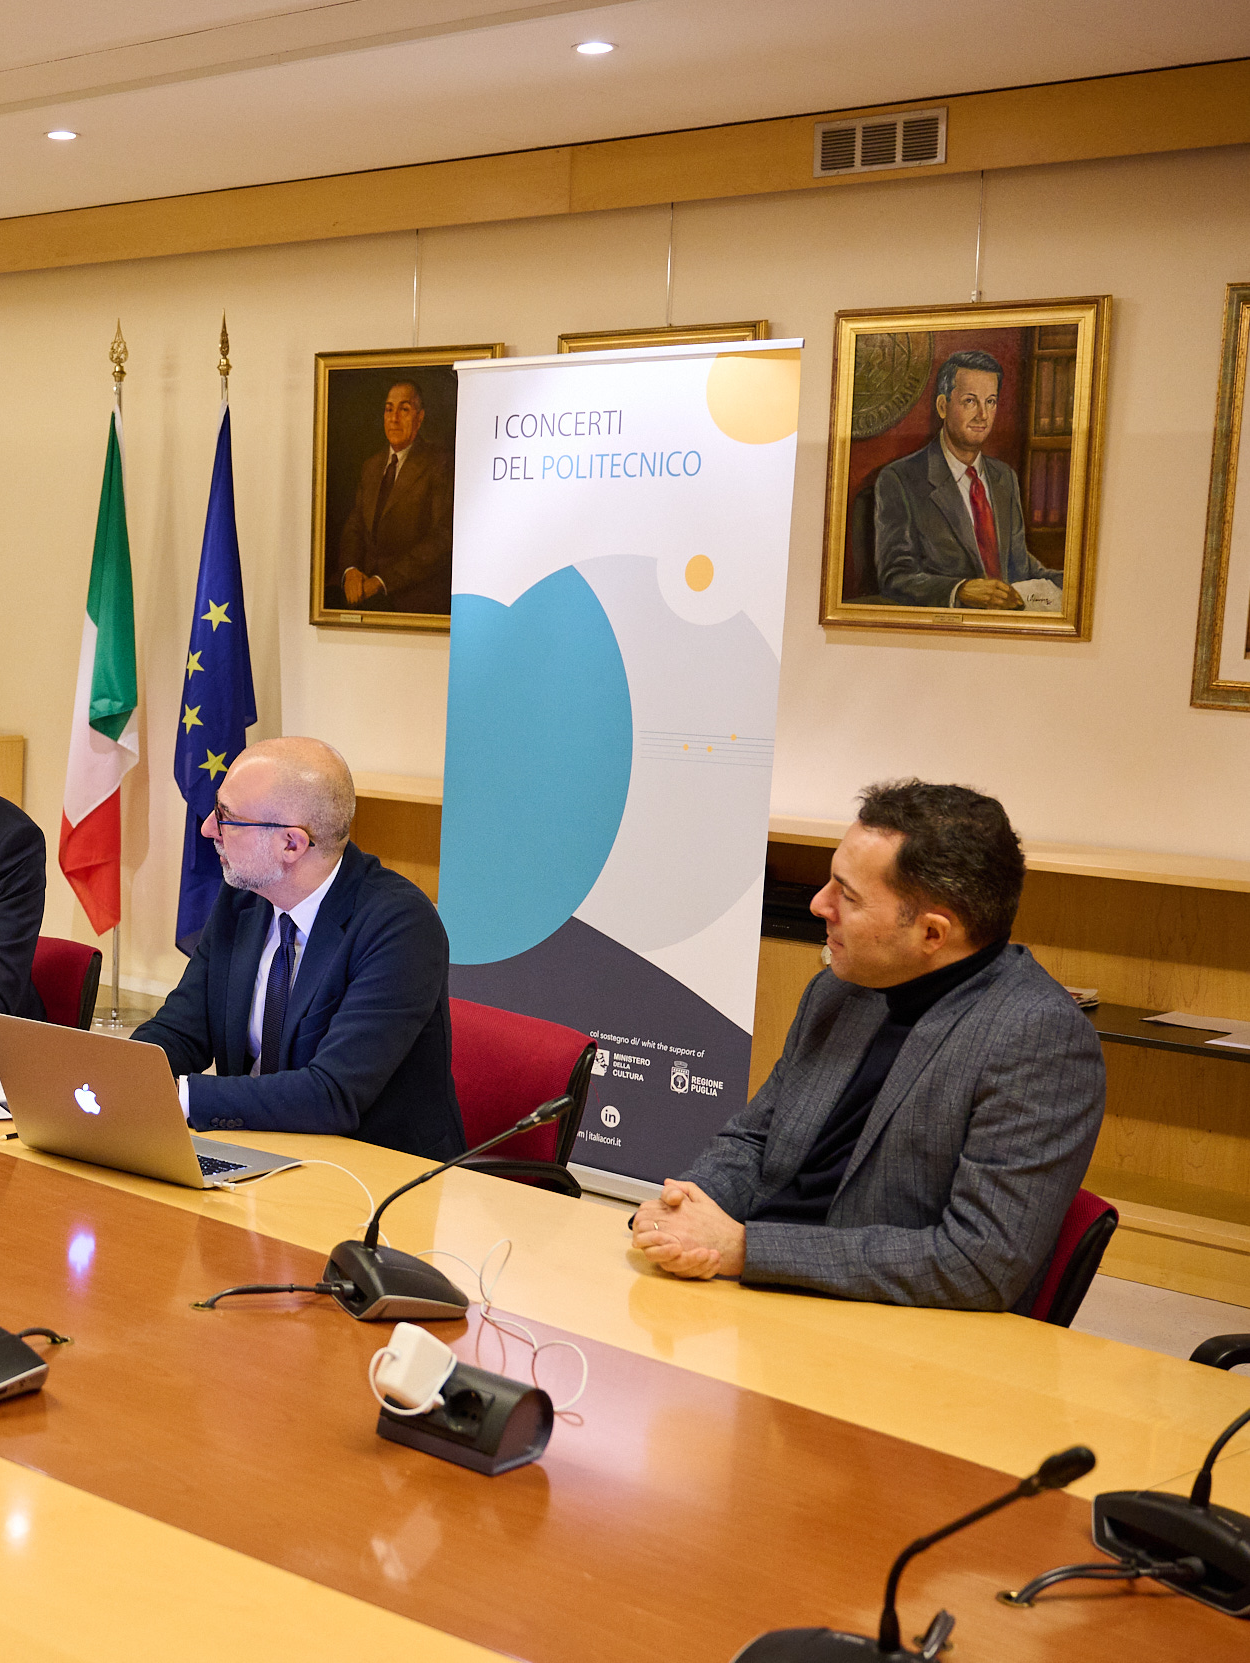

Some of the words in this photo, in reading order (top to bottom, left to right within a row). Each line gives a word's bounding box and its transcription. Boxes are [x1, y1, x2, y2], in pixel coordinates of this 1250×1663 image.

[494, 415, 499, 439] I
[505, 409, 623, 439] CONCERTI
[492, 456, 534, 481] DEL
[542, 450, 702, 480] POLITECNICO
[600, 1033, 629, 1044] sostegno
[642, 1039, 656, 1049] whit
[657, 1042, 668, 1051] the
[669, 1045, 696, 1056] support
[697, 1050, 705, 1058] of
[613, 1053, 651, 1067] MINISTERO
[613, 1061, 631, 1070] DELLA
[612, 1069, 645, 1082] CULTURA
[691, 1076, 724, 1090] REGIONE
[690, 1084, 718, 1097] PUGLIA
[589, 1132, 621, 1147] italiacori.it
